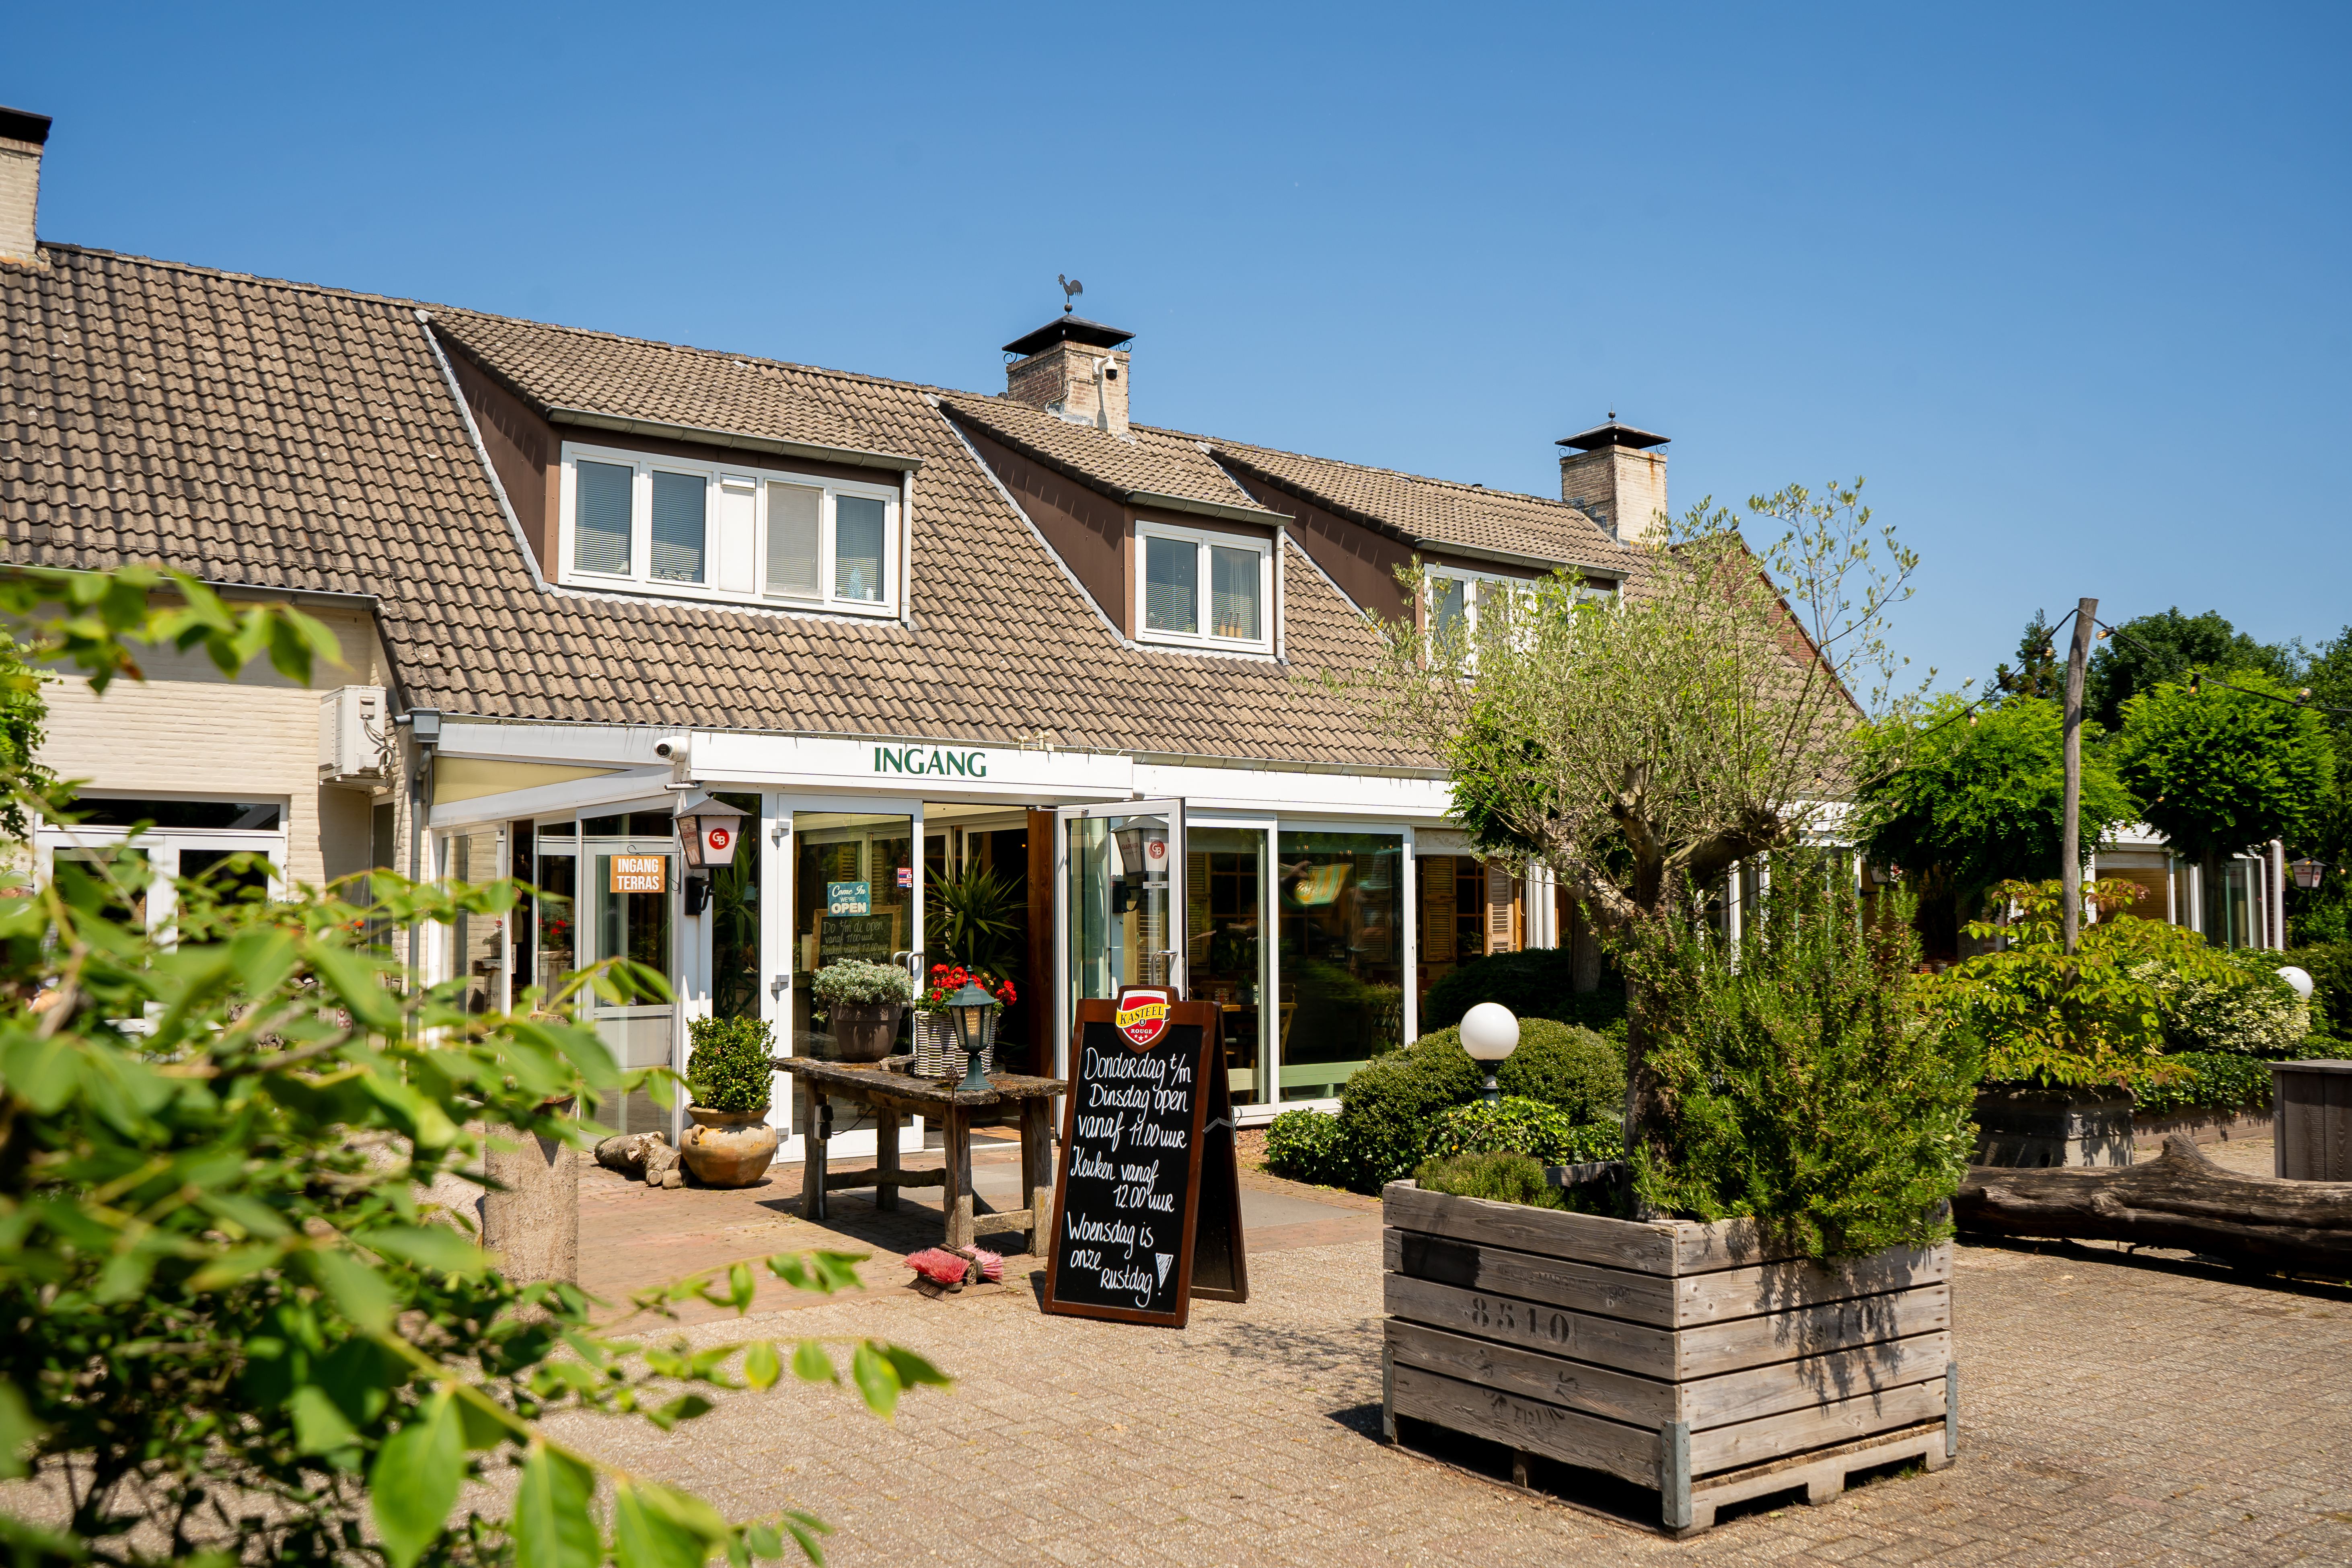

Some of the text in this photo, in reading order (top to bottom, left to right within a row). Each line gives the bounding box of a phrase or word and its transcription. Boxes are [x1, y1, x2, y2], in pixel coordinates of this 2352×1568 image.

[874, 746, 987, 777] INGANG
[712, 832, 726, 845] GB
[618, 858, 659, 873] INGANG
[617, 875, 659, 890] TERRAS
[832, 885, 866, 897] Come In
[831, 902, 867, 914] OPEN
[822, 921, 836, 934] Do
[839, 920, 851, 934] t/m
[825, 933, 844, 946] vanaf
[820, 945, 843, 956] Keuken
[844, 943, 861, 957] vanaf
[1120, 1006, 1164, 1024] KASTEEL
[1170, 1053, 1192, 1086] t/m
[1089, 1083, 1188, 1123] Dinsdag open
[1078, 1111, 1125, 1152] vanaf
[1129, 1122, 1160, 1147] 11.00
[1070, 1145, 1159, 1196] Keuken vanaf
[1113, 1184, 1146, 1208] 12.00
[1067, 1211, 1153, 1260] Woensdag is
[1070, 1249, 1102, 1270] onze
[1471, 1297, 1569, 1344] 8510
